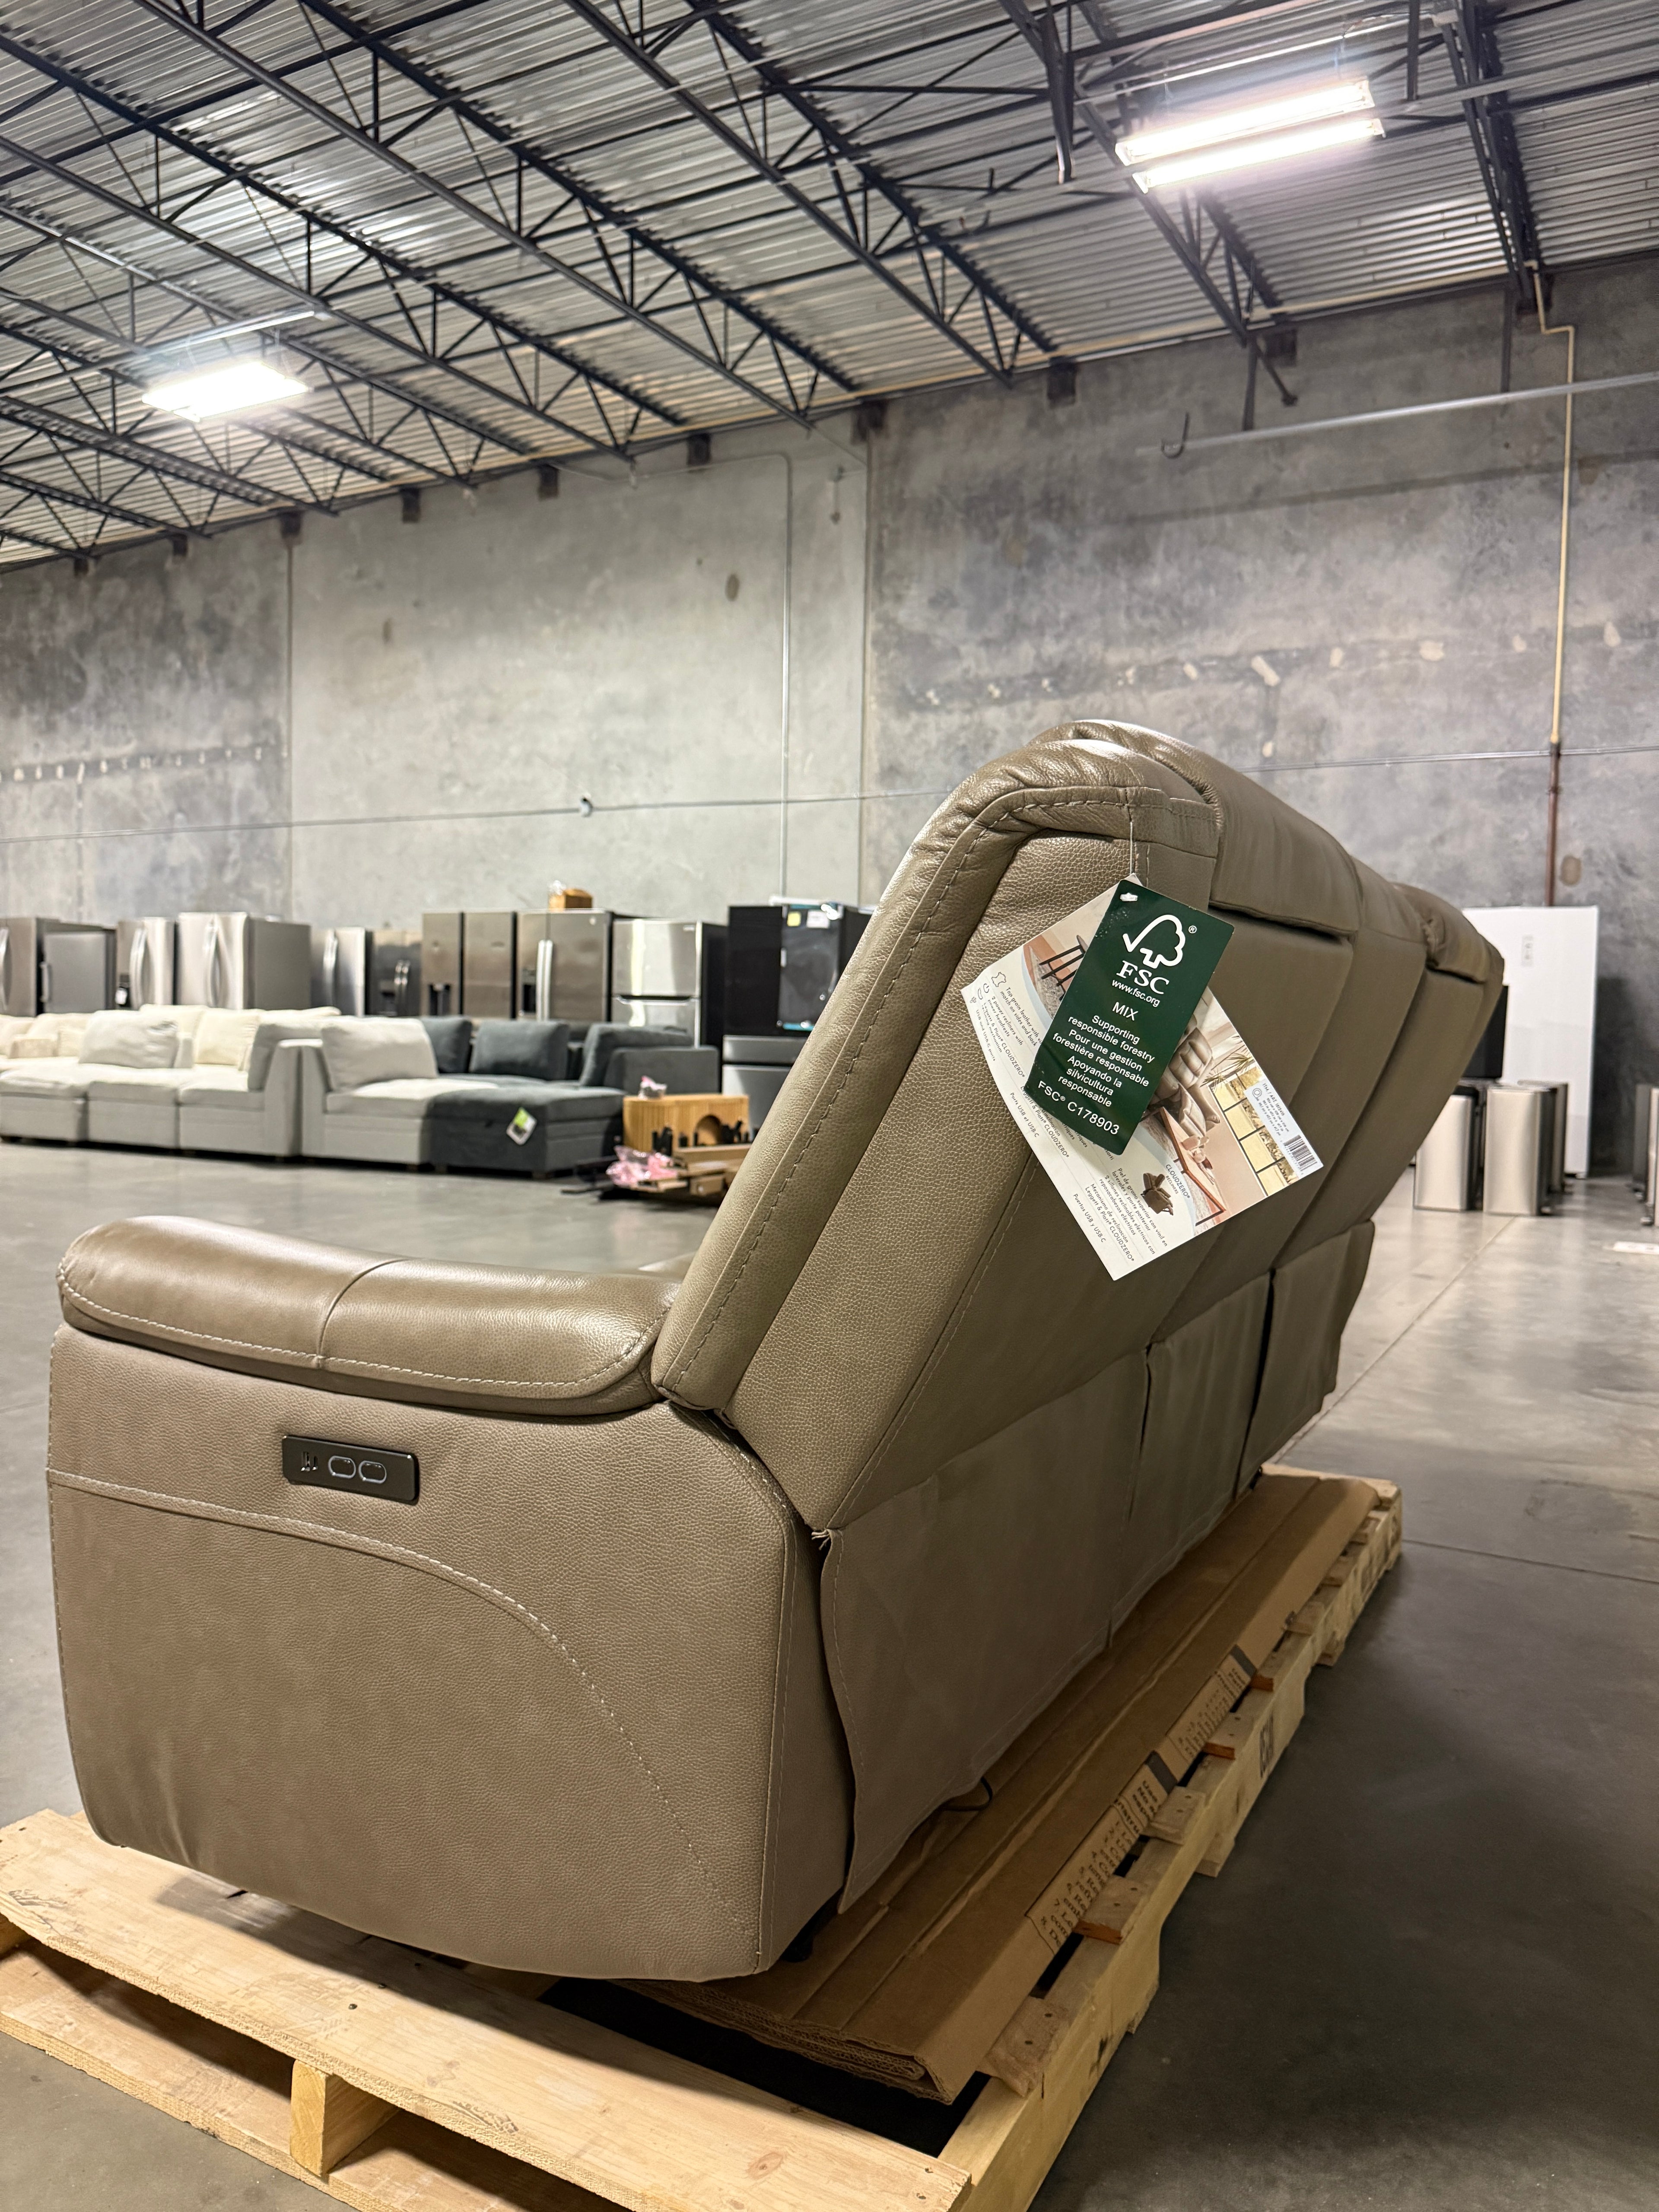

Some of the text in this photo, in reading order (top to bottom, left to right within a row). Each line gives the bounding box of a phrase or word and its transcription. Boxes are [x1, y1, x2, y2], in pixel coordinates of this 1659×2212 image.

[1112, 979, 1160, 1007] www.fsc.org
[1116, 960, 1169, 994] FSC
[987, 999, 1010, 1037] power headrests
[992, 1001, 1004, 1015] power
[1002, 1015, 1016, 1035] recliners
[1015, 1036, 1023, 1046] with
[1000, 991, 1012, 1006] match
[1014, 1013, 1023, 1025] sides
[1021, 1025, 1031, 1035] and
[1027, 1033, 1037, 1047] back
[1009, 997, 1021, 1010] grain
[1019, 1009, 1032, 1027] leather
[1030, 1027, 1039, 1038] with
[1092, 1015, 1140, 1045] Supporting
[1112, 1001, 1138, 1021] MIX
[1068, 1017, 1155, 1063] responsible forestry
[1068, 1029, 1142, 1071] Pour une gestion
[1001, 1042, 1025, 1077] CLOUDZERO®
[1053, 1033, 1149, 1086] forestière responsable
[1067, 1055, 1122, 1088] Apoyando la
[1058, 1076, 1111, 1106] responsable
[1066, 1068, 1113, 1095] silvicultura
[1009, 1092, 1018, 1105] Ports
[1017, 1105, 1026, 1116] USB
[1038, 1080, 1119, 1134] FSC® C178903
[1044, 1124, 1069, 1157] CLOUDZERO®
[1163, 1175, 1179, 1194] RECLINERS
[1165, 1163, 1190, 1198] CLOUDZERO®
[1072, 1193, 1085, 1212] Puertos
[1084, 1211, 1093, 1223] USB
[1090, 1183, 1108, 1210] Mecanismo
[1111, 1217, 1128, 1243] reclinación
[1099, 1179, 1136, 1236] reposacabezas eléctricos
[1107, 1178, 1119, 1197] sillones
[1118, 1197, 1135, 1223] reclinables
[1134, 1223, 1149, 1245] eléctricos
[1111, 1170, 1126, 1192] laterales
[1126, 1196, 1137, 1209] parte
[1134, 1210, 1150, 1231] posterior
[1117, 1167, 1126, 1178] Piel
[1126, 1185, 1138, 1199] grano
[1136, 1200, 1150, 1219] superior
[1155, 1229, 1165, 1239] vinil
[1084, 1186, 1099, 1205] Leggett
[1109, 1225, 1135, 1261] CLOUDZERO®
